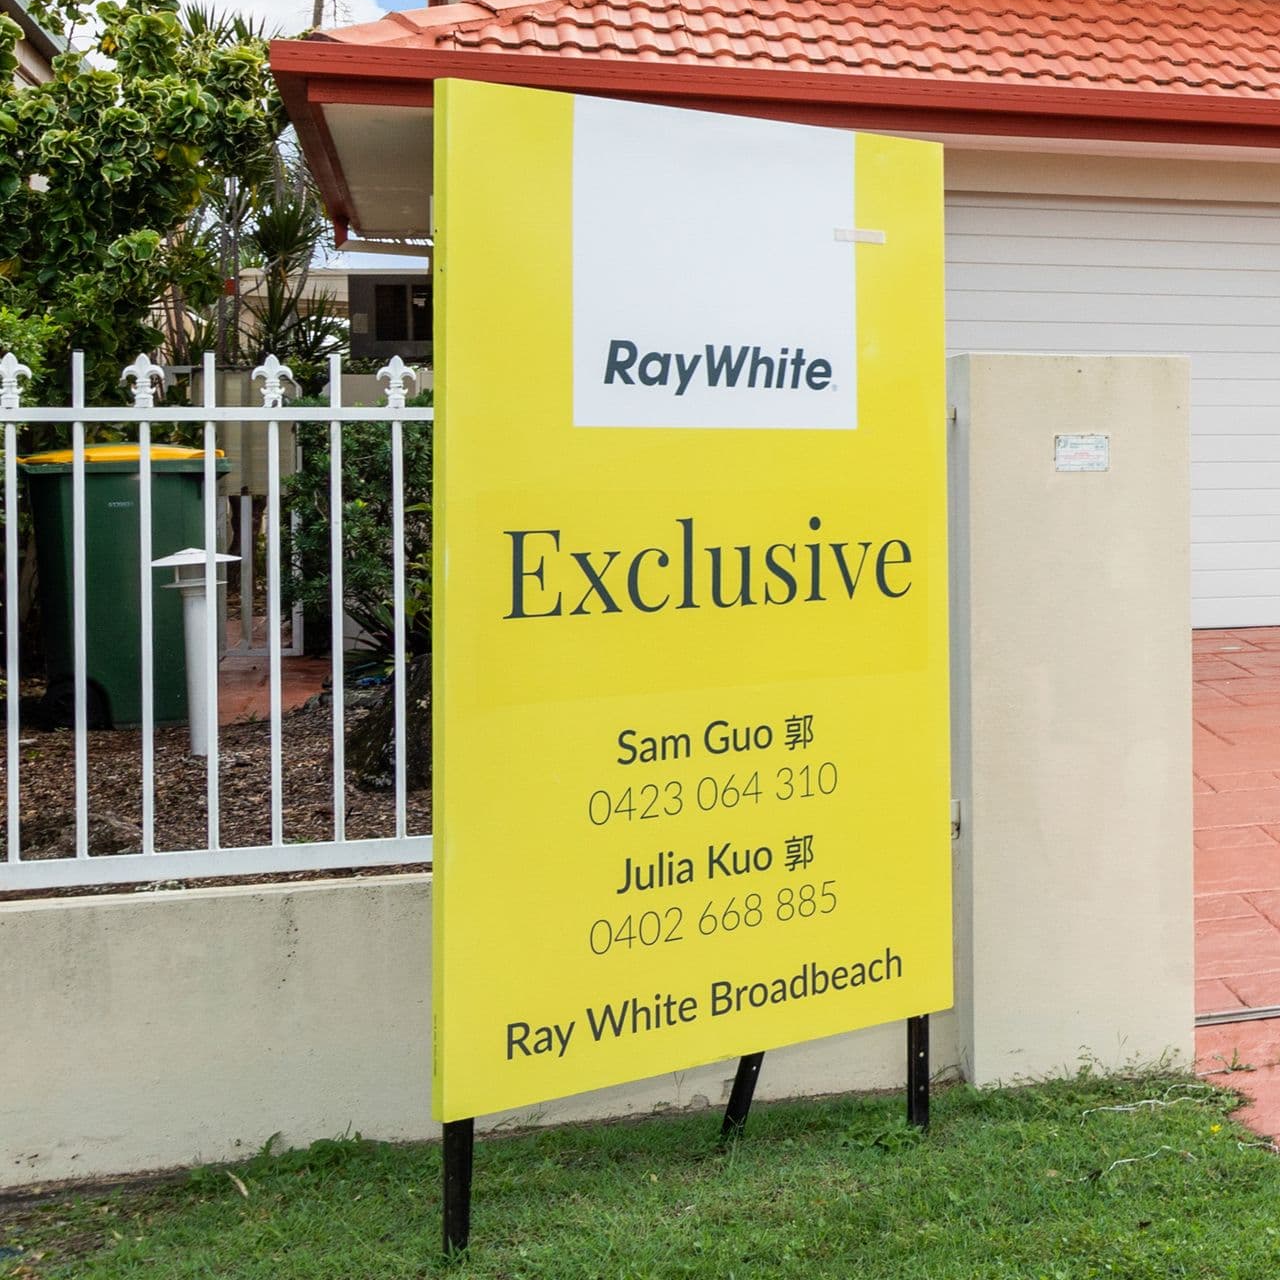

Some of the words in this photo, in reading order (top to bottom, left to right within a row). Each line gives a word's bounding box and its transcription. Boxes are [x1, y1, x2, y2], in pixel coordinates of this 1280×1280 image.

[503, 516, 911, 619] Exclusive
[617, 730, 690, 765] Sam
[704, 720, 773, 754] Guo
[784, 715, 813, 751] 郭
[589, 781, 683, 825] 0423
[697, 771, 763, 811] 064
[776, 762, 837, 800] 310
[617, 851, 693, 894] Julia
[708, 843, 772, 879] Kuo
[784, 835, 813, 872] 郭
[590, 907, 683, 955] 0402
[699, 894, 762, 935] 668
[777, 880, 836, 921] 885
[507, 1021, 575, 1060] Ray
[586, 994, 697, 1041] White
[712, 947, 901, 1016] Broadbeach
